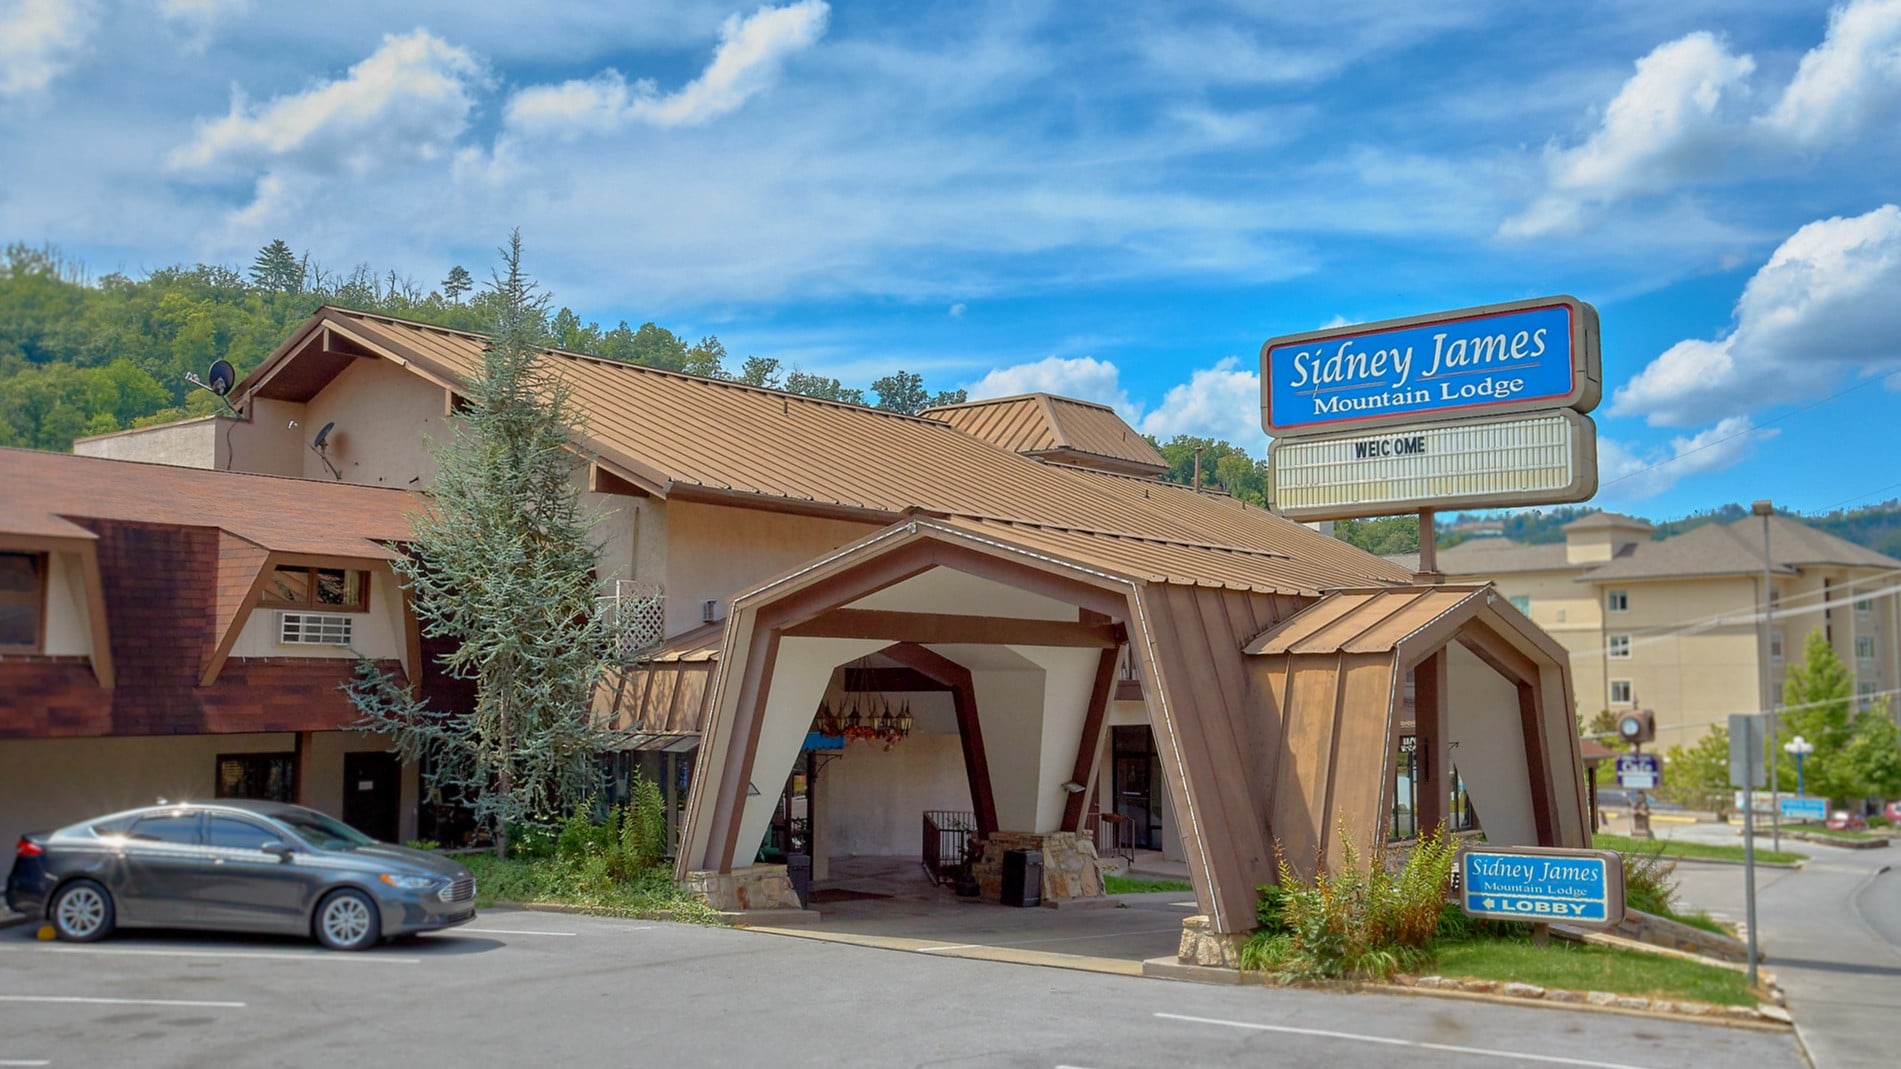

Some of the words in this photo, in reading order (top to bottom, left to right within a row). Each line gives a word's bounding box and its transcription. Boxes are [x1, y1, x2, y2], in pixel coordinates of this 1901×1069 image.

[1290, 341, 1414, 389] Sidney
[1421, 328, 1548, 377] James
[1313, 387, 1432, 415] Mountain
[1440, 377, 1525, 399] Lodge
[1471, 857, 1535, 885] Sidney
[1538, 862, 1600, 882] James
[1484, 881, 1543, 894] Mountain
[1547, 885, 1588, 898] Lodge
[1501, 899, 1587, 915] LOBBY
